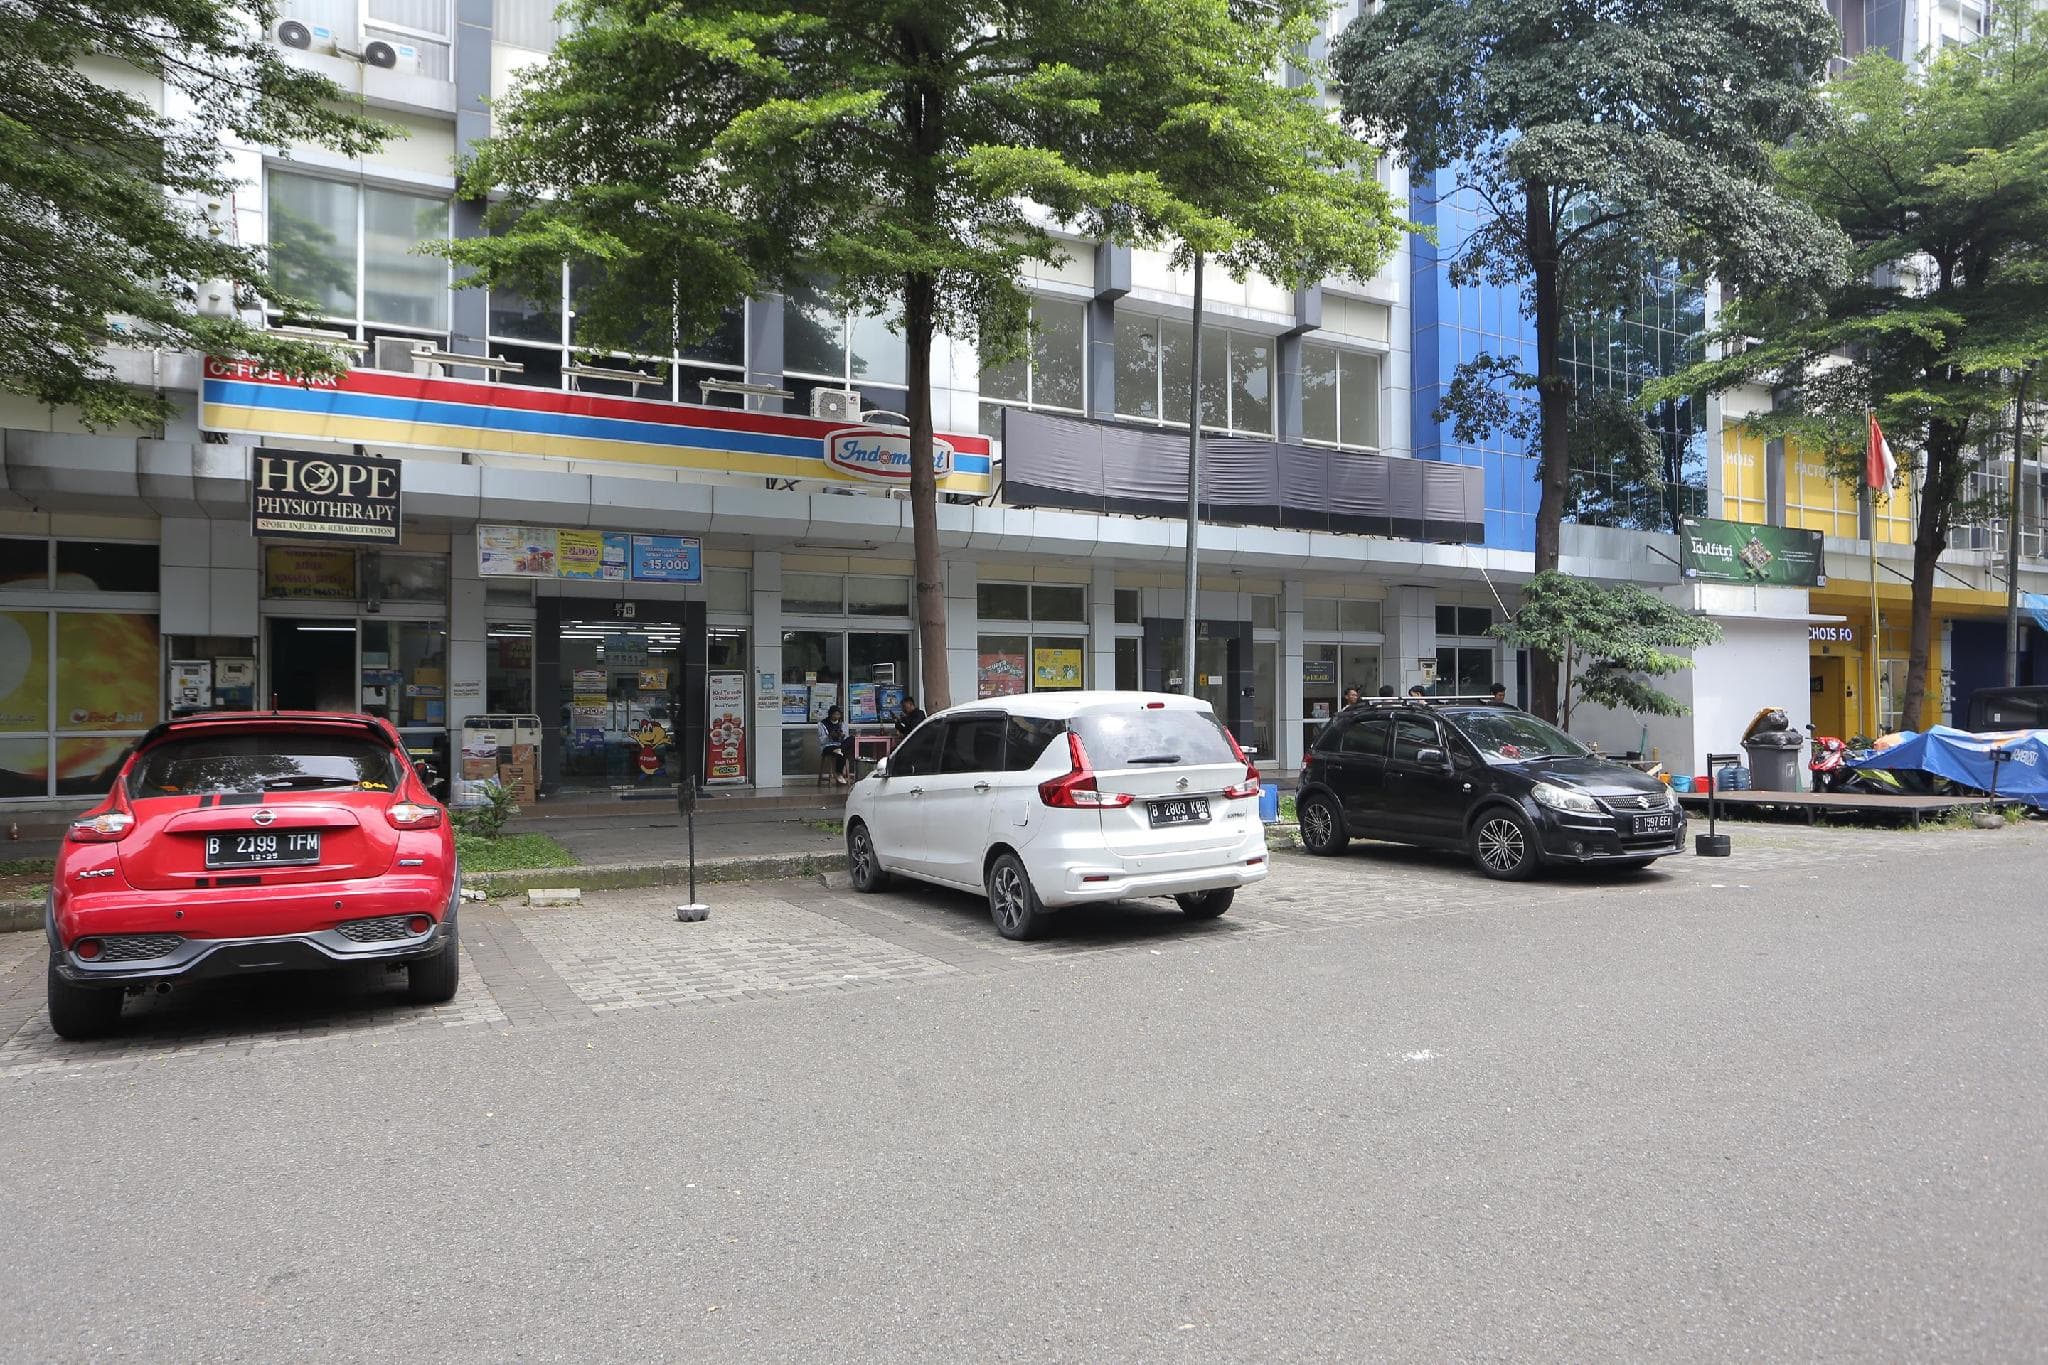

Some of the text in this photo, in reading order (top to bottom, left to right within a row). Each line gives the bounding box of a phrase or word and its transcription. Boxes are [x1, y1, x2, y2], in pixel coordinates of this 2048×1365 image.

[838, 440, 945, 469] Indomat
[1723, 451, 1755, 467] HOIS
[257, 457, 397, 499] HOPE
[257, 496, 396, 521] PHYSIOTHERAPY
[261, 520, 286, 529] SPORT
[289, 522, 317, 531] INJURY
[328, 525, 393, 535] REHABILITATION
[1691, 540, 1733, 557] Idulfitri
[1164, 802, 1186, 816] 2803
[209, 837, 220, 855] B
[288, 833, 318, 851] TFM
